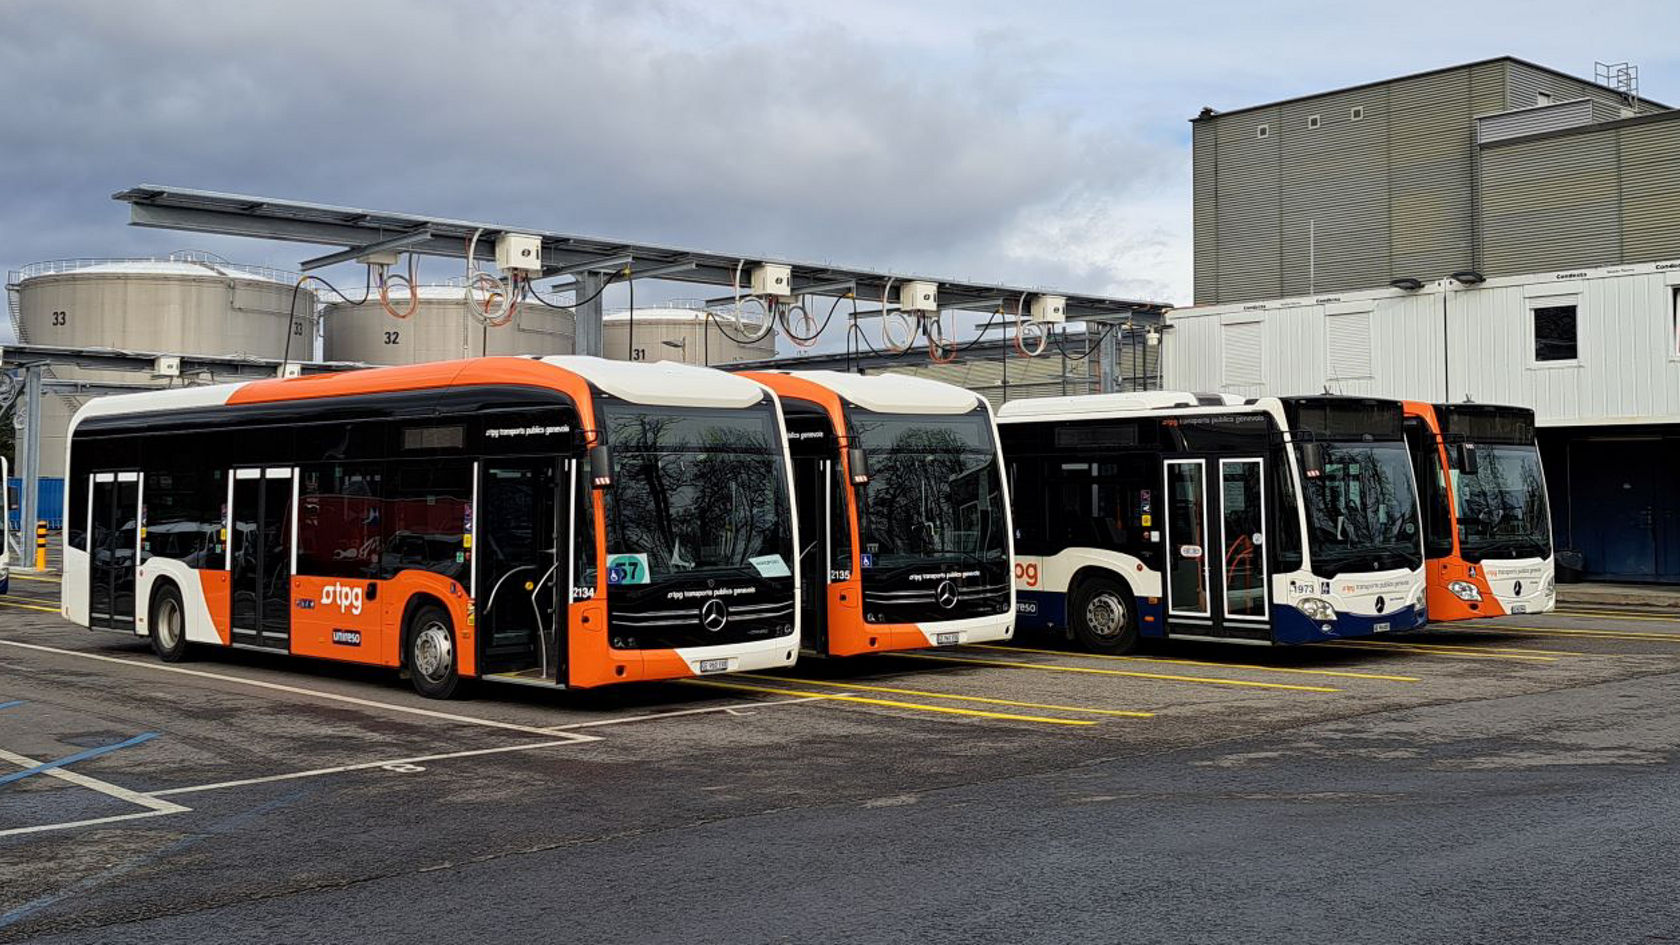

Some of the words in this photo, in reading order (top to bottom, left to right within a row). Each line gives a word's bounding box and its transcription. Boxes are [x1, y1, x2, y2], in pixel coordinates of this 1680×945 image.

[52, 311, 66, 326] 33
[294, 321, 303, 336] 33
[384, 331, 400, 345] 32
[633, 349, 646, 361] 31
[1235, 414, 1265, 424] genevois
[545, 424, 570, 436] genevois
[615, 562, 638, 580] 57
[830, 569, 850, 580] 2135
[572, 587, 595, 598] 2134
[1293, 584, 1315, 594] 1973
[333, 631, 361, 643] unireso
